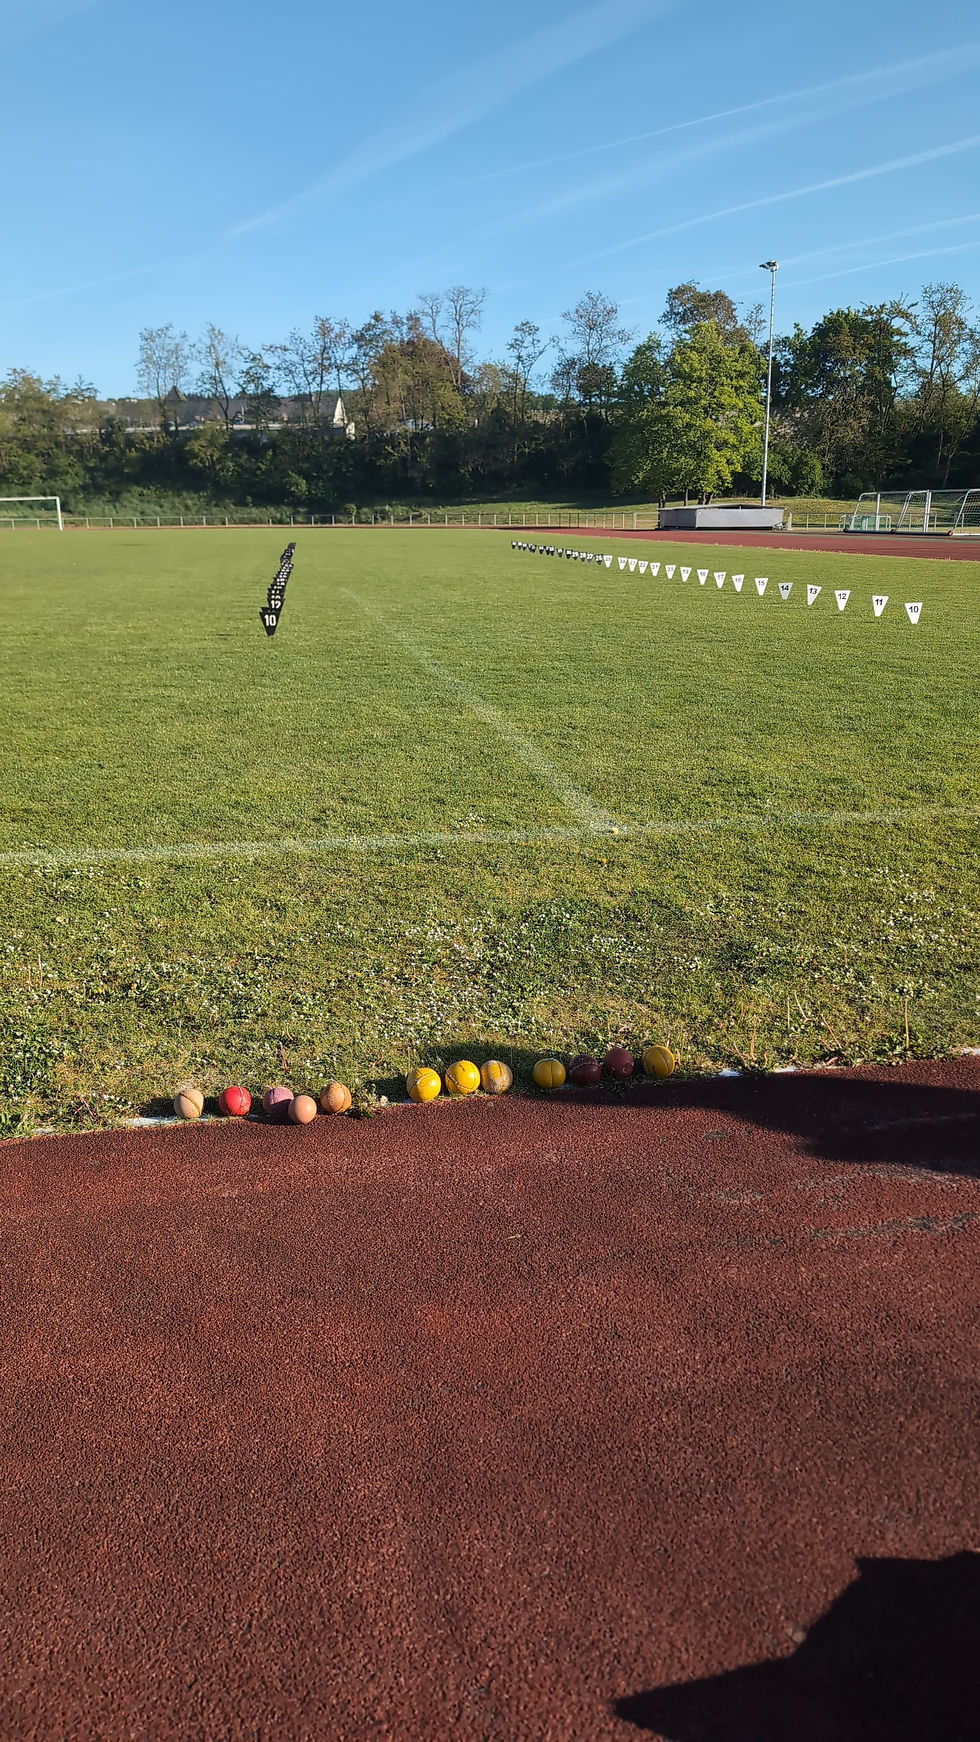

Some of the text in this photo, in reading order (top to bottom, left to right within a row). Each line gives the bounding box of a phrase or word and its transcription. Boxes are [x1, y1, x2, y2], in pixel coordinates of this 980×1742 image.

[809, 587, 818, 595] 13
[838, 592, 847, 600] 12
[874, 598, 883, 606] 11
[908, 605, 919, 613] 10
[264, 614, 277, 627] 10
